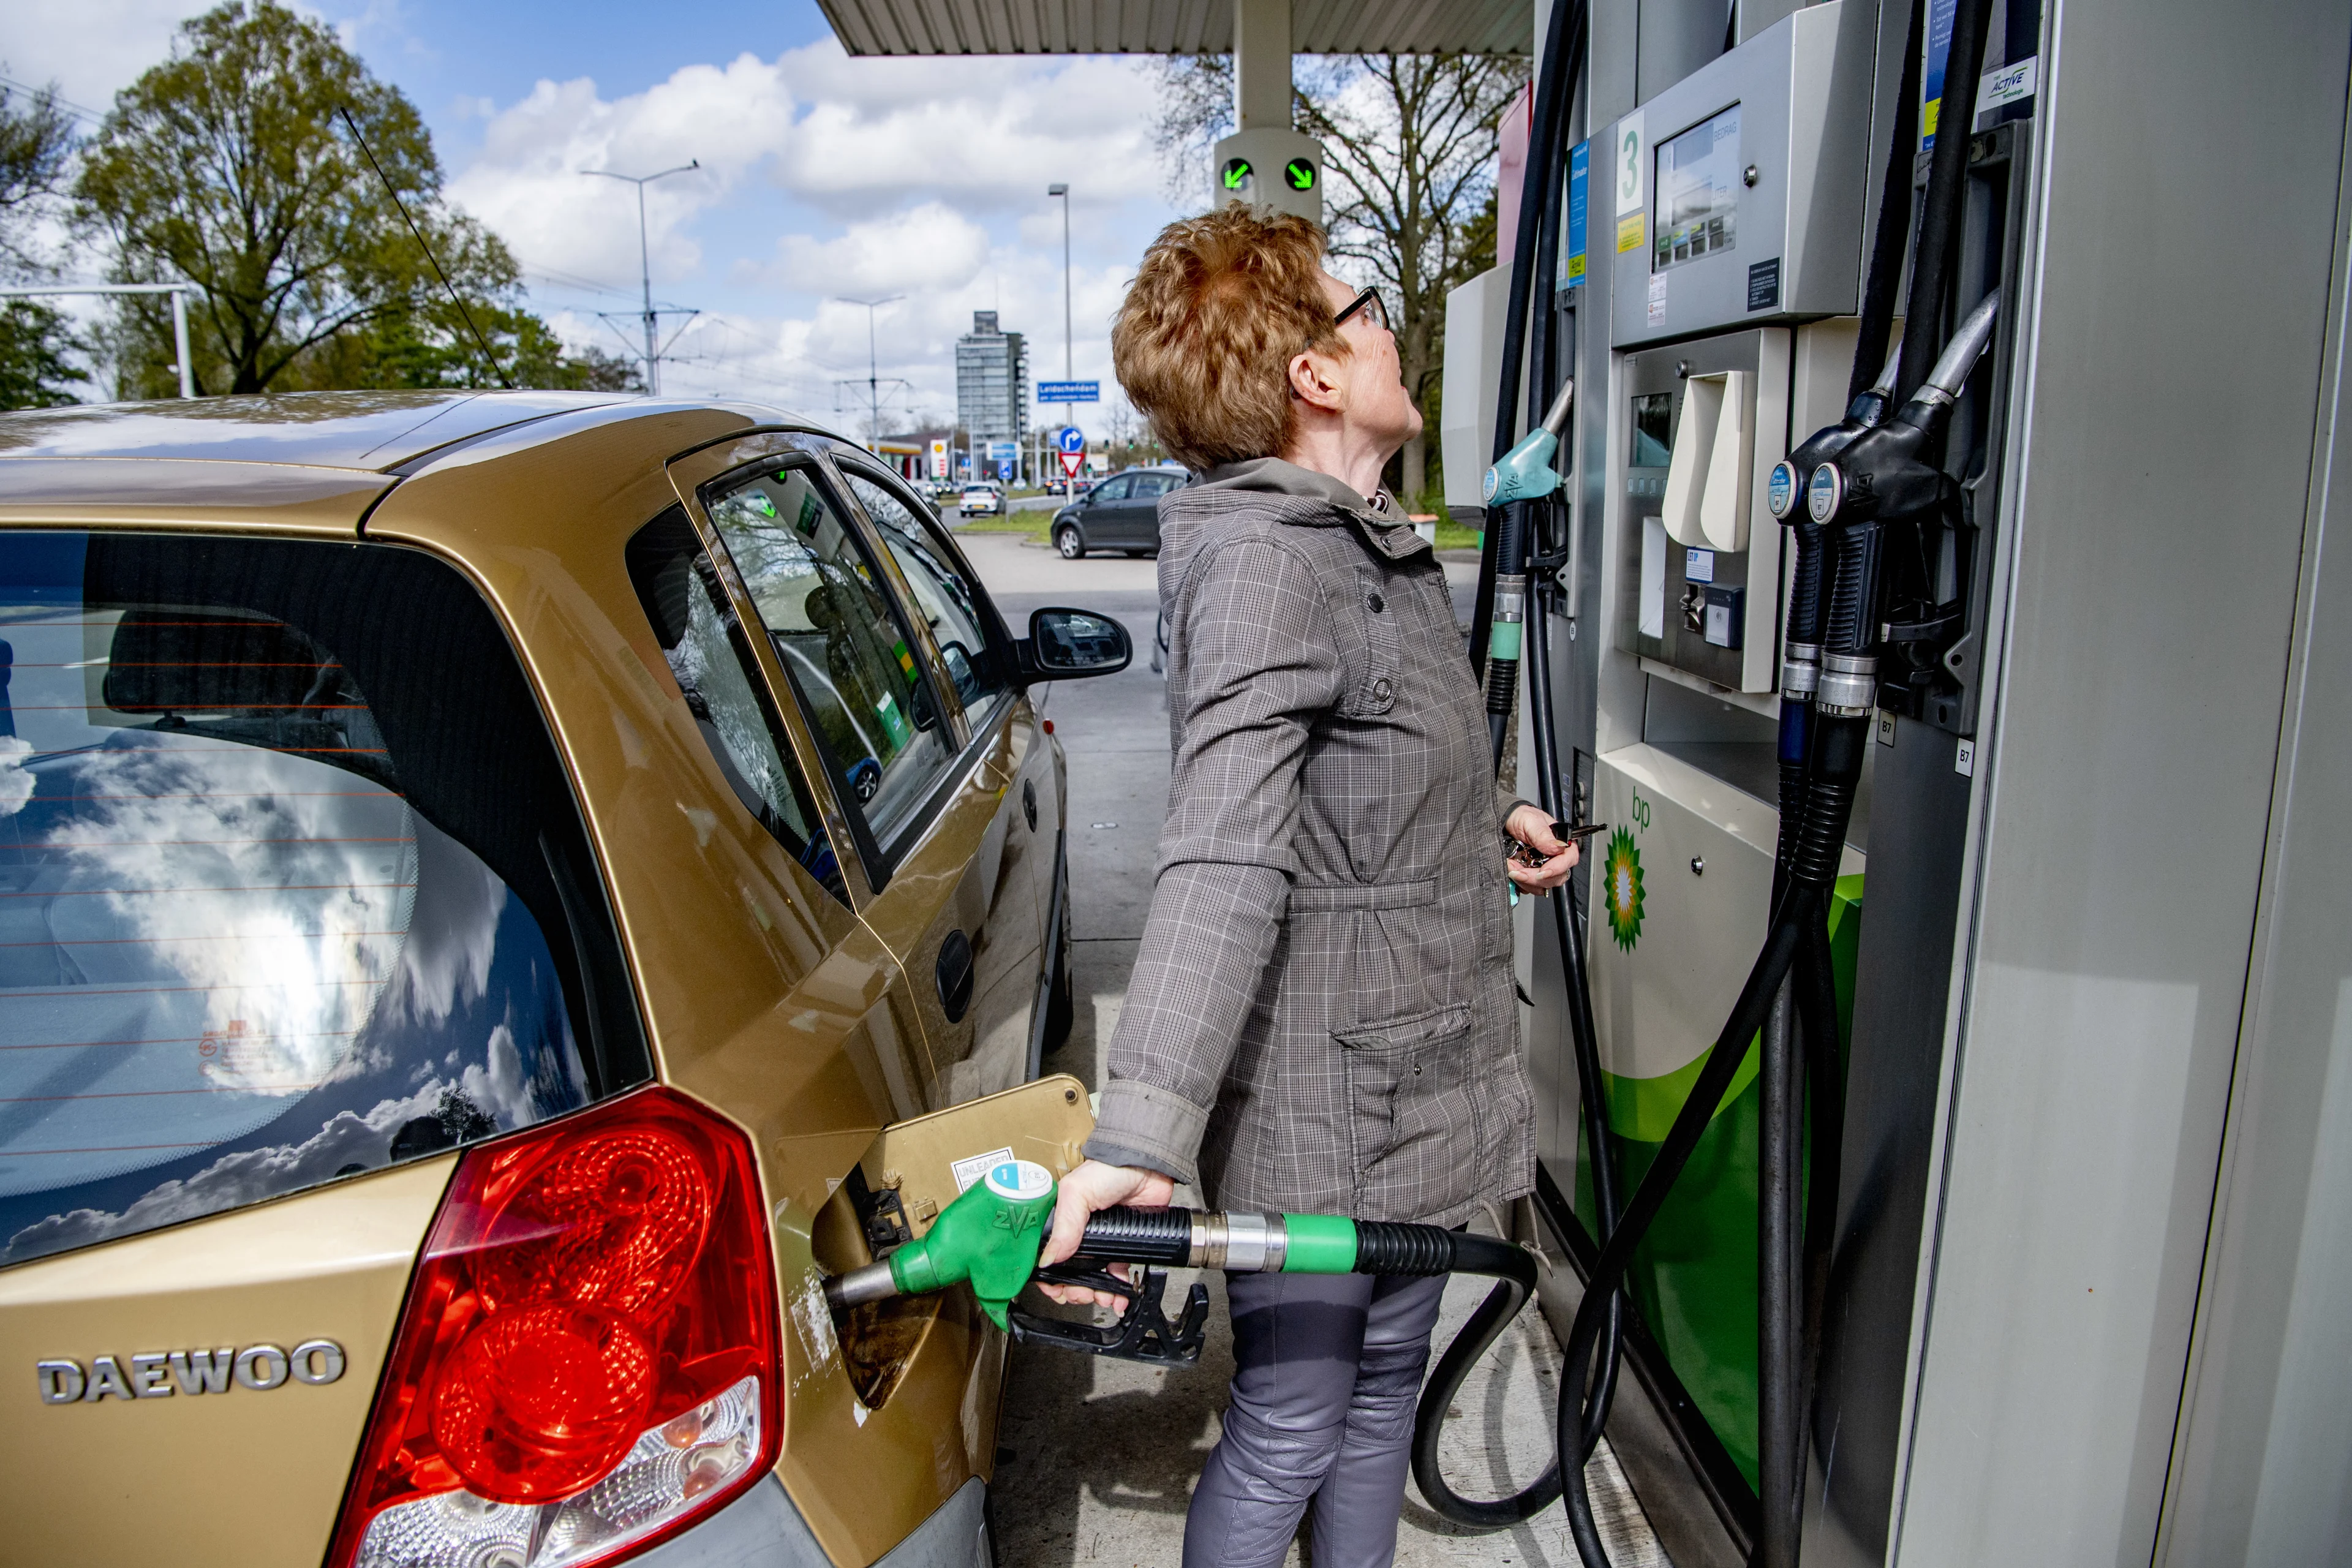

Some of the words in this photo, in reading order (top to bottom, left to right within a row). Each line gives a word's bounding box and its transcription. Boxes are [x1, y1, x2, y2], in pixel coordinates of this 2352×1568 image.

[1991, 72, 2024, 94] ACTIVE
[2003, 88, 2024, 99] technologie
[1714, 122, 1736, 142] BEDRAG
[1623, 130, 1638, 199] 3
[1712, 186, 1727, 200] LITER
[1040, 383, 1097, 393] Leidschendam
[1694, 552, 1698, 562] OP
[1882, 720, 1891, 734] B7
[1960, 749, 1970, 763] B7
[1632, 786, 1650, 834] bp
[992, 1205, 1042, 1239] ZVA
[37, 1338, 347, 1404] DAEWOO
